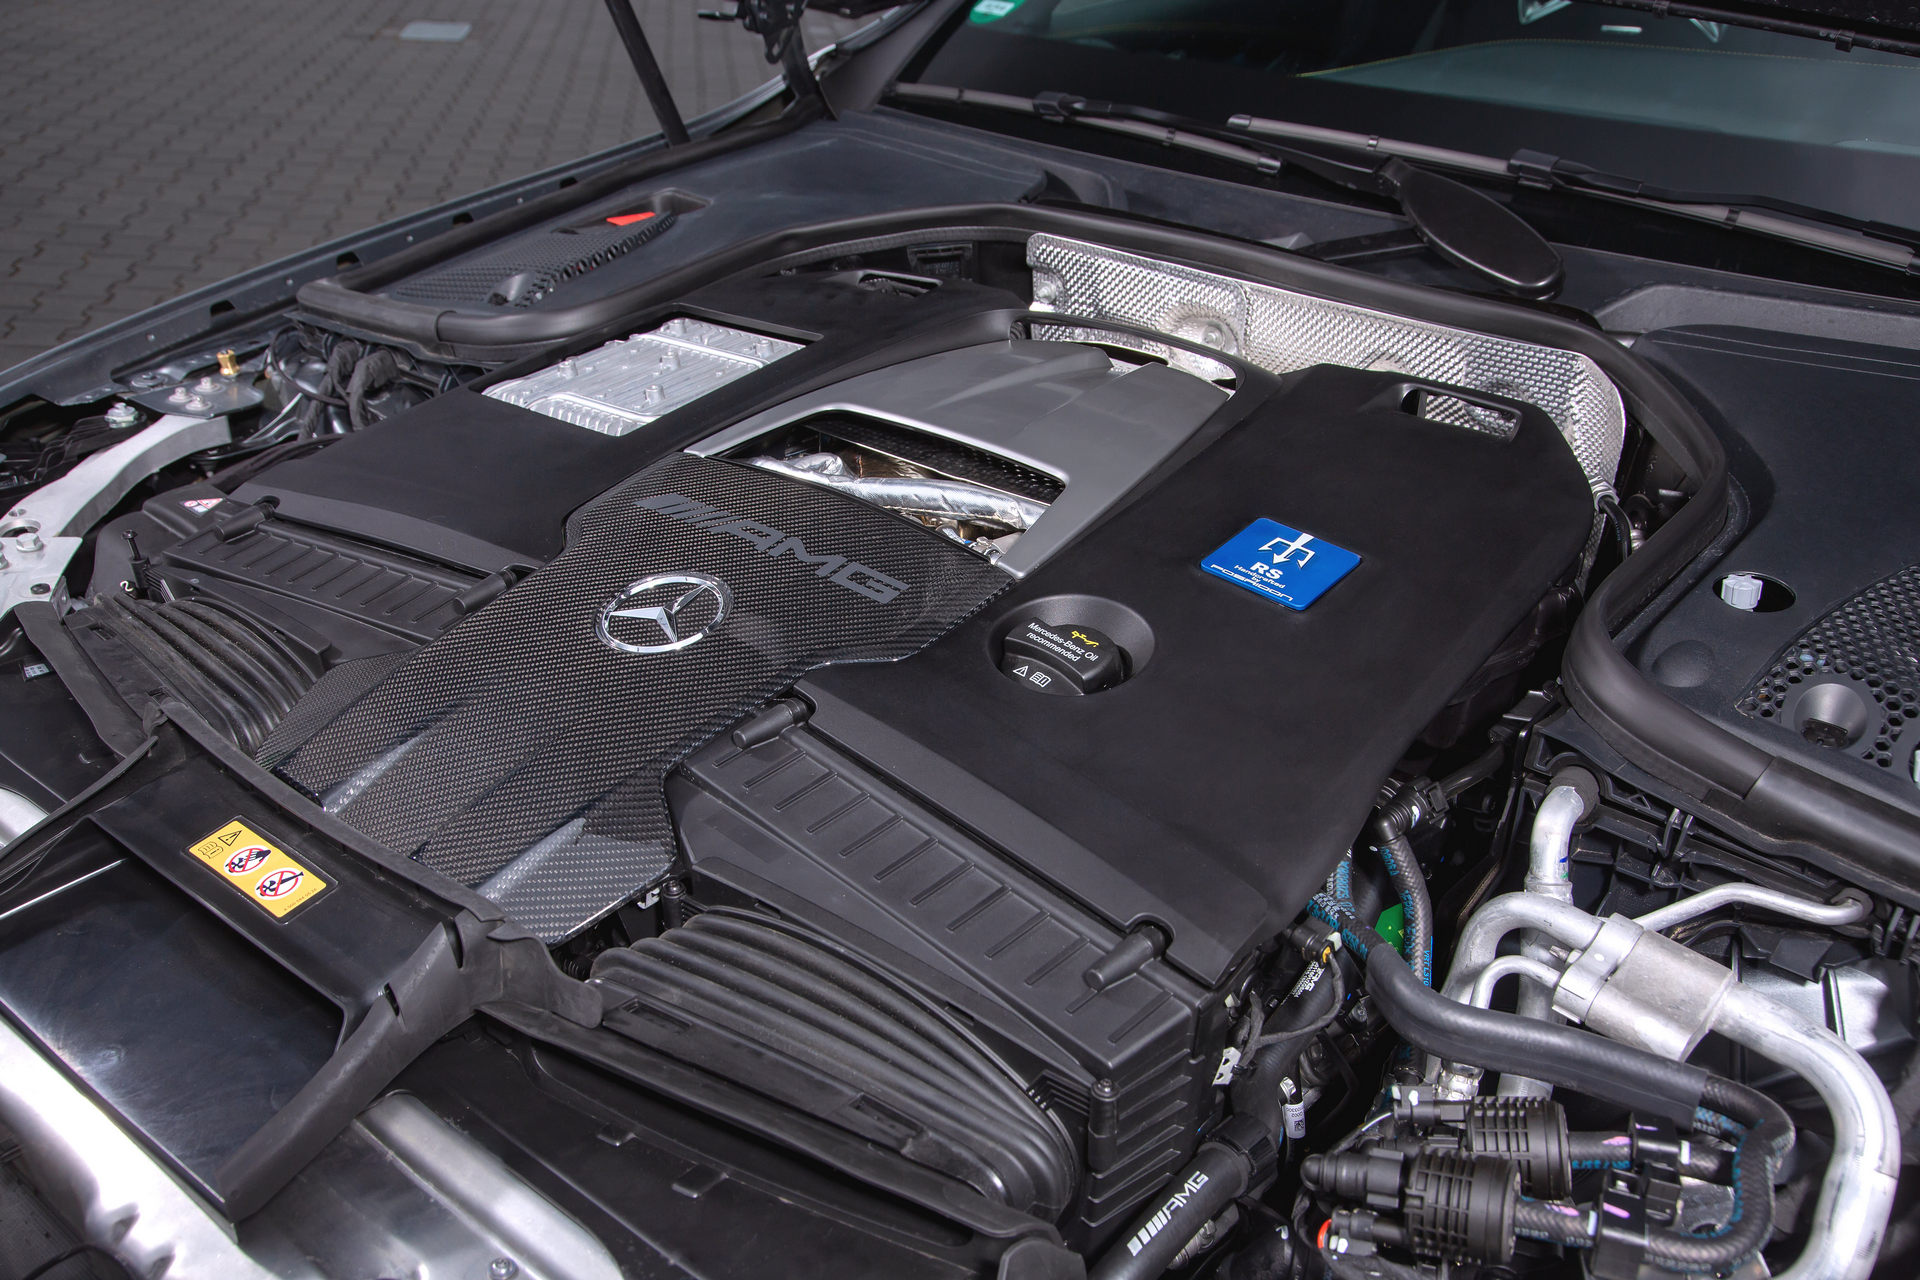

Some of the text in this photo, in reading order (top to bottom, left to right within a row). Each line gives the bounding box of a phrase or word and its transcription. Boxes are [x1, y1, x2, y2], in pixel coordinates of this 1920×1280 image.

[706, 518, 910, 604] AMG
[1250, 561, 1284, 580] RS
[1234, 564, 1286, 589] Handcrafted
[1252, 575, 1261, 583] by
[1026, 632, 1081, 662] recommended
[1028, 622, 1099, 662] Mercedes-Benz Oil
[1162, 1171, 1209, 1220] AMG
